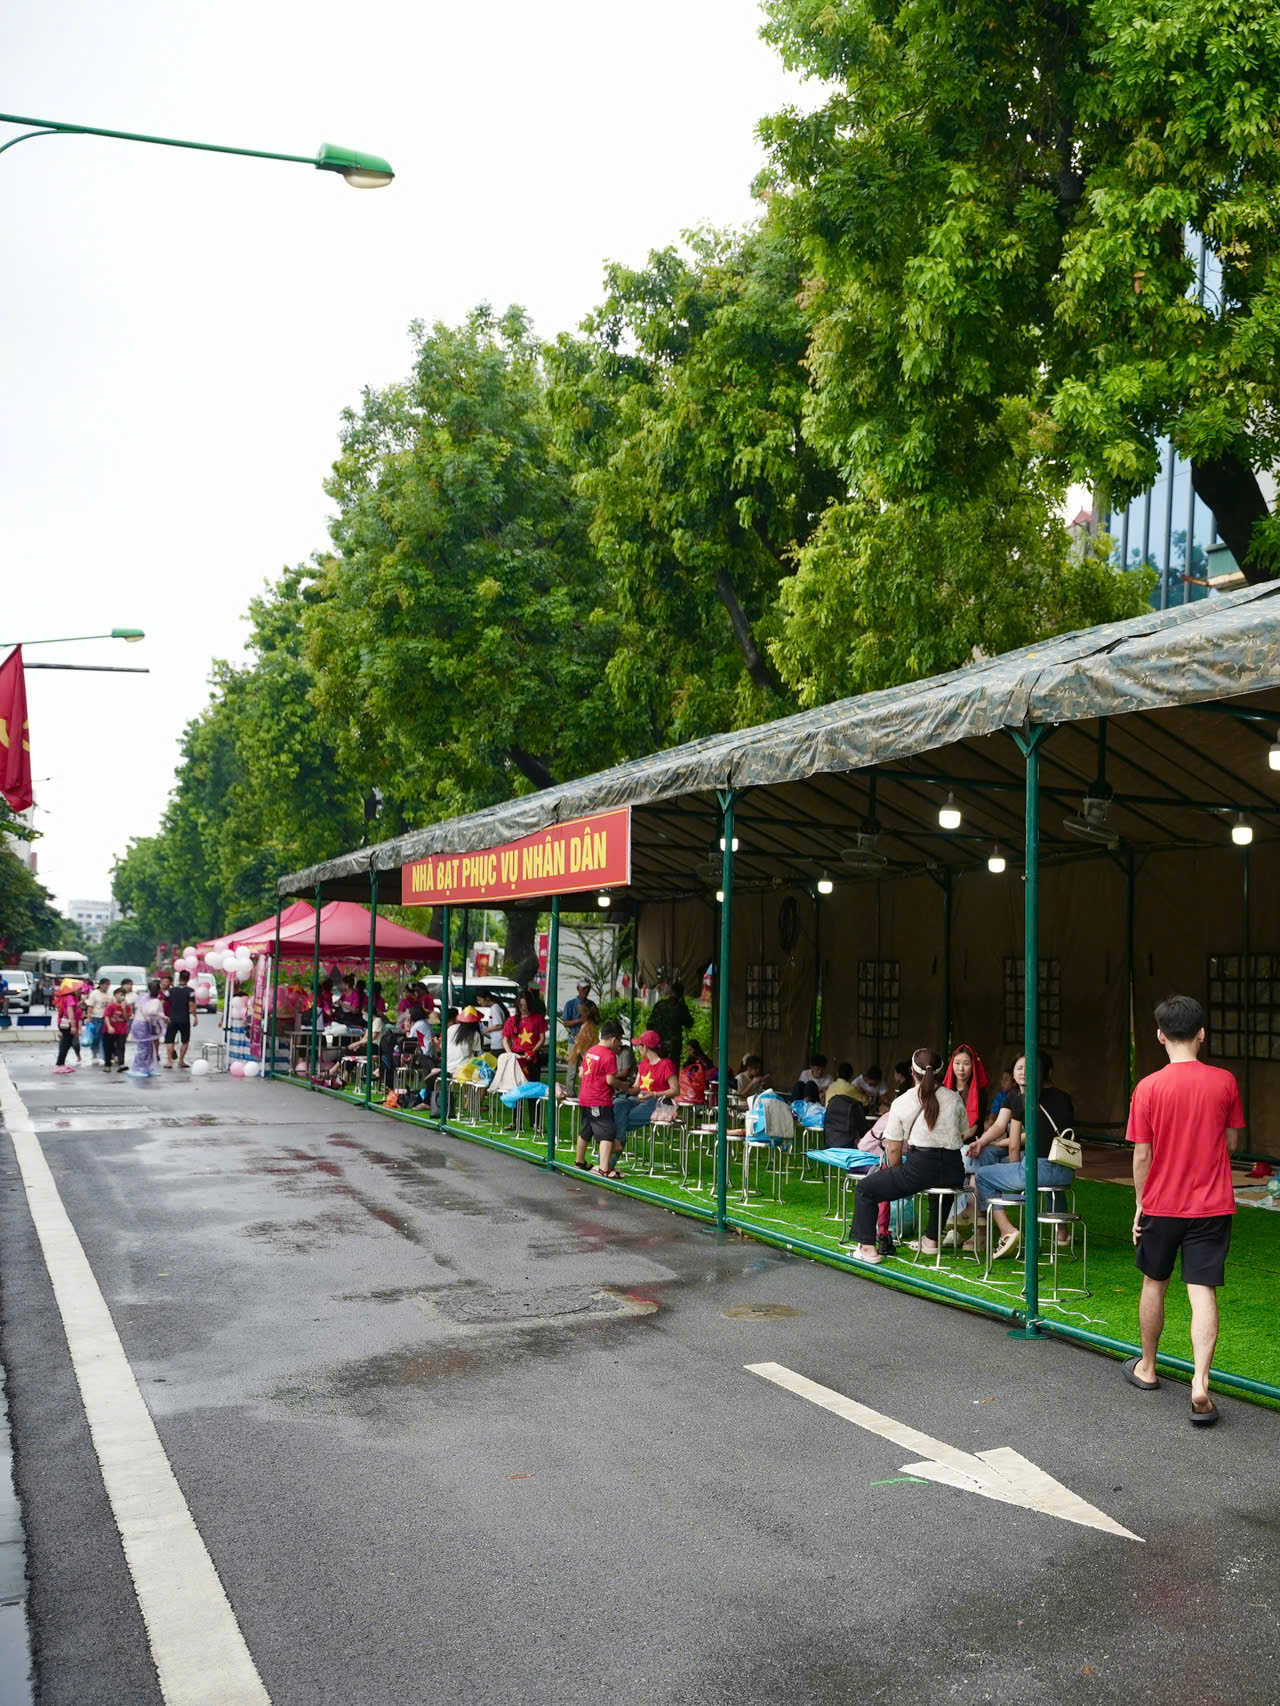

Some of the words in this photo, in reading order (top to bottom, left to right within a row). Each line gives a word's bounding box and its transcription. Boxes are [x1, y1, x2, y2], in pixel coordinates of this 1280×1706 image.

[412, 858, 434, 892] NHÀ
[437, 860, 459, 895] BẠT
[462, 854, 497, 893] PHỤC
[501, 849, 519, 889] VỤ
[522, 836, 566, 880] NHÂN
[570, 827, 607, 873] DÂN
